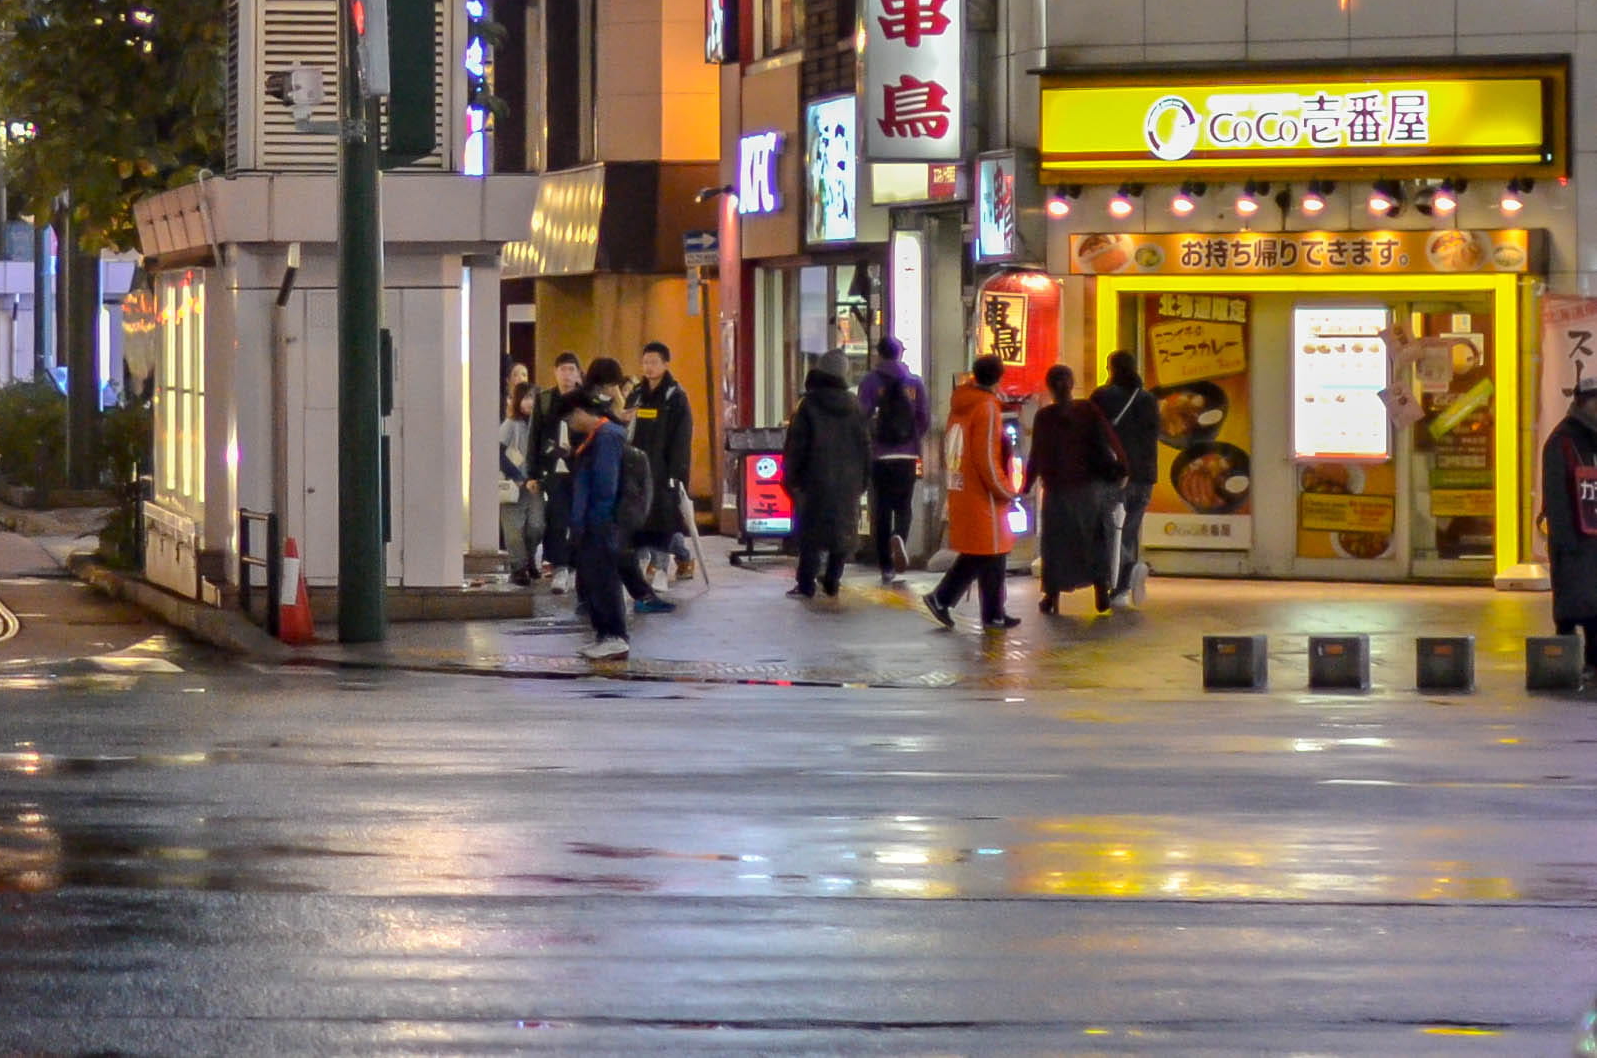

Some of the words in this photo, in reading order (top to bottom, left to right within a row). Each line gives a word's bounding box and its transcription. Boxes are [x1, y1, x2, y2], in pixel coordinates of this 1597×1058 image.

[1181, 239, 1409, 268] お持ち帰りできます。
